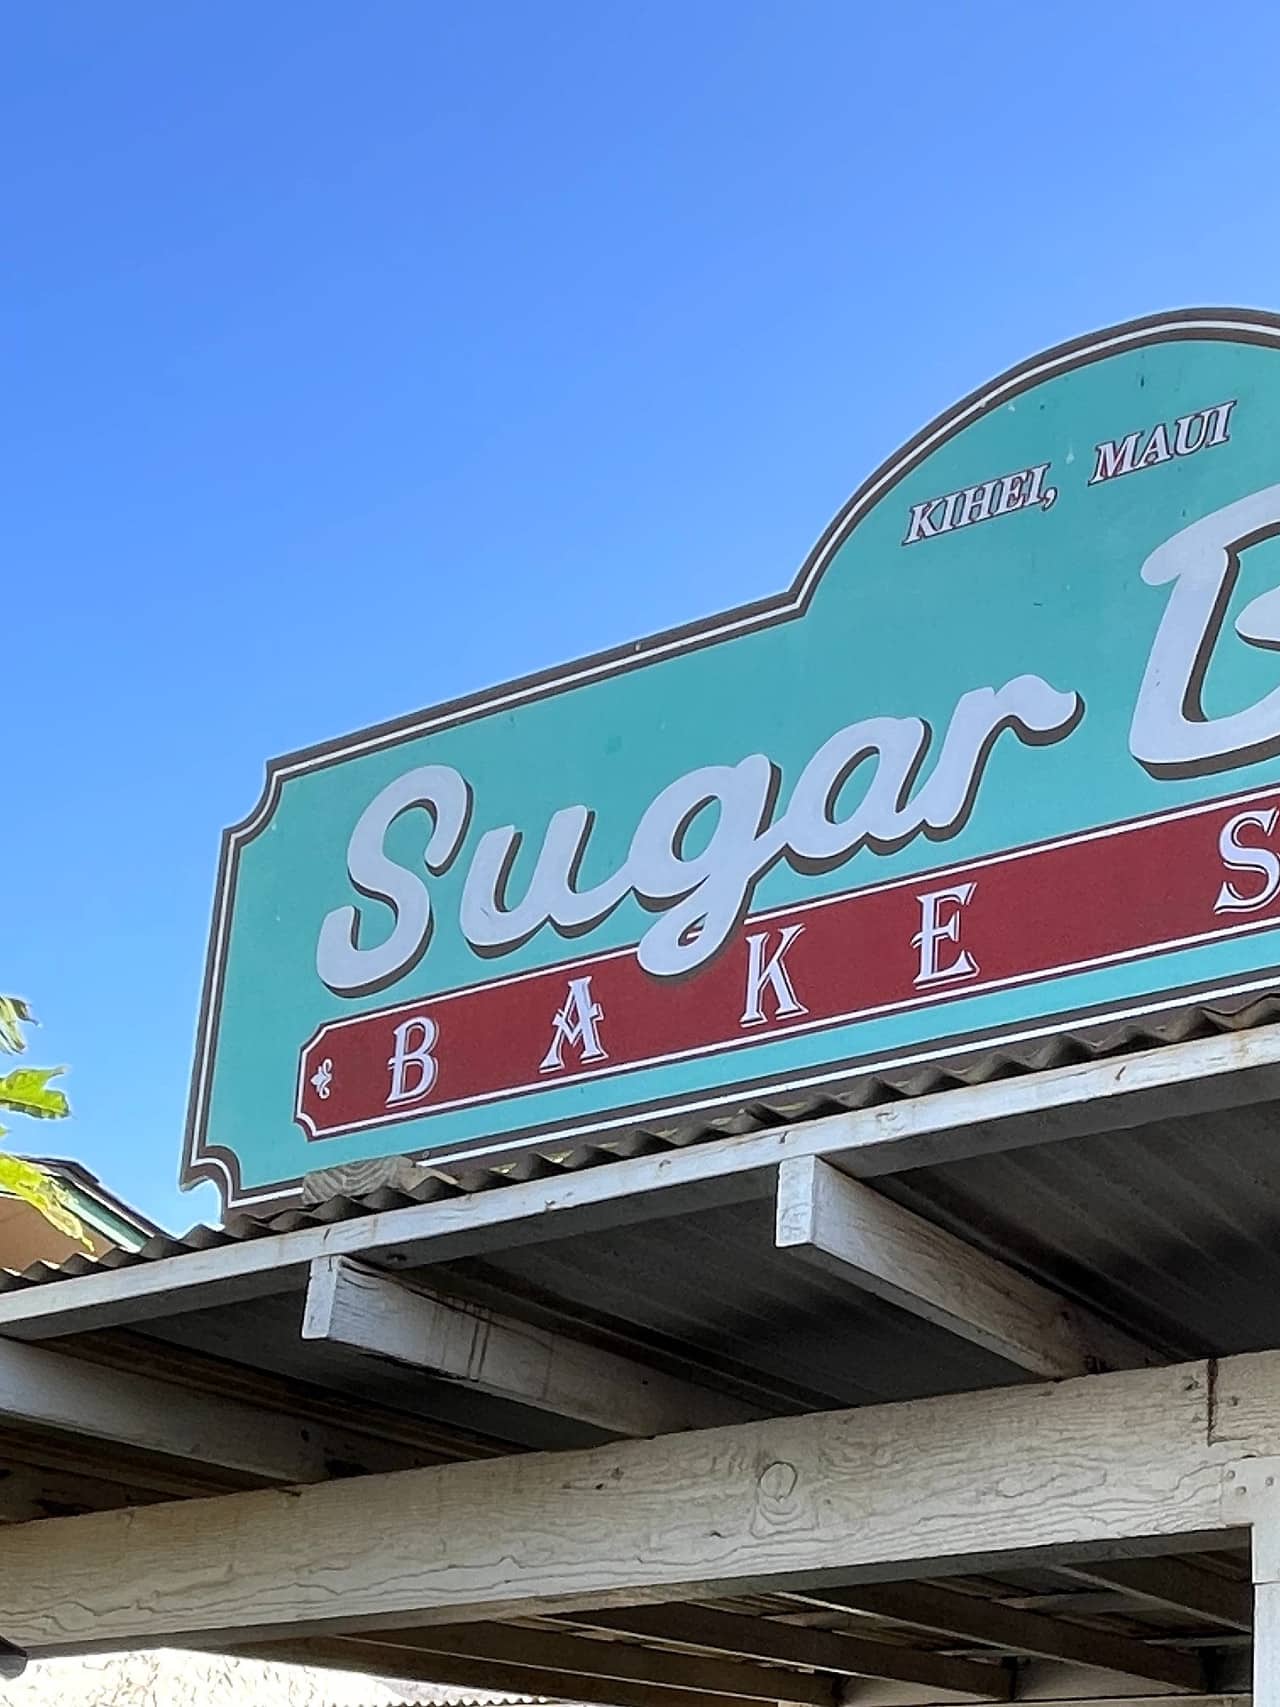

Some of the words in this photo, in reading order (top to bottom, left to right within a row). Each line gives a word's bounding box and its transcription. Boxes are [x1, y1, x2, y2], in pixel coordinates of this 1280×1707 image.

[902, 462, 1057, 545] KIHEI,
[1087, 400, 1237, 486] MAUI
[316, 674, 1081, 993] Sugar
[385, 882, 981, 1109] BAKE
